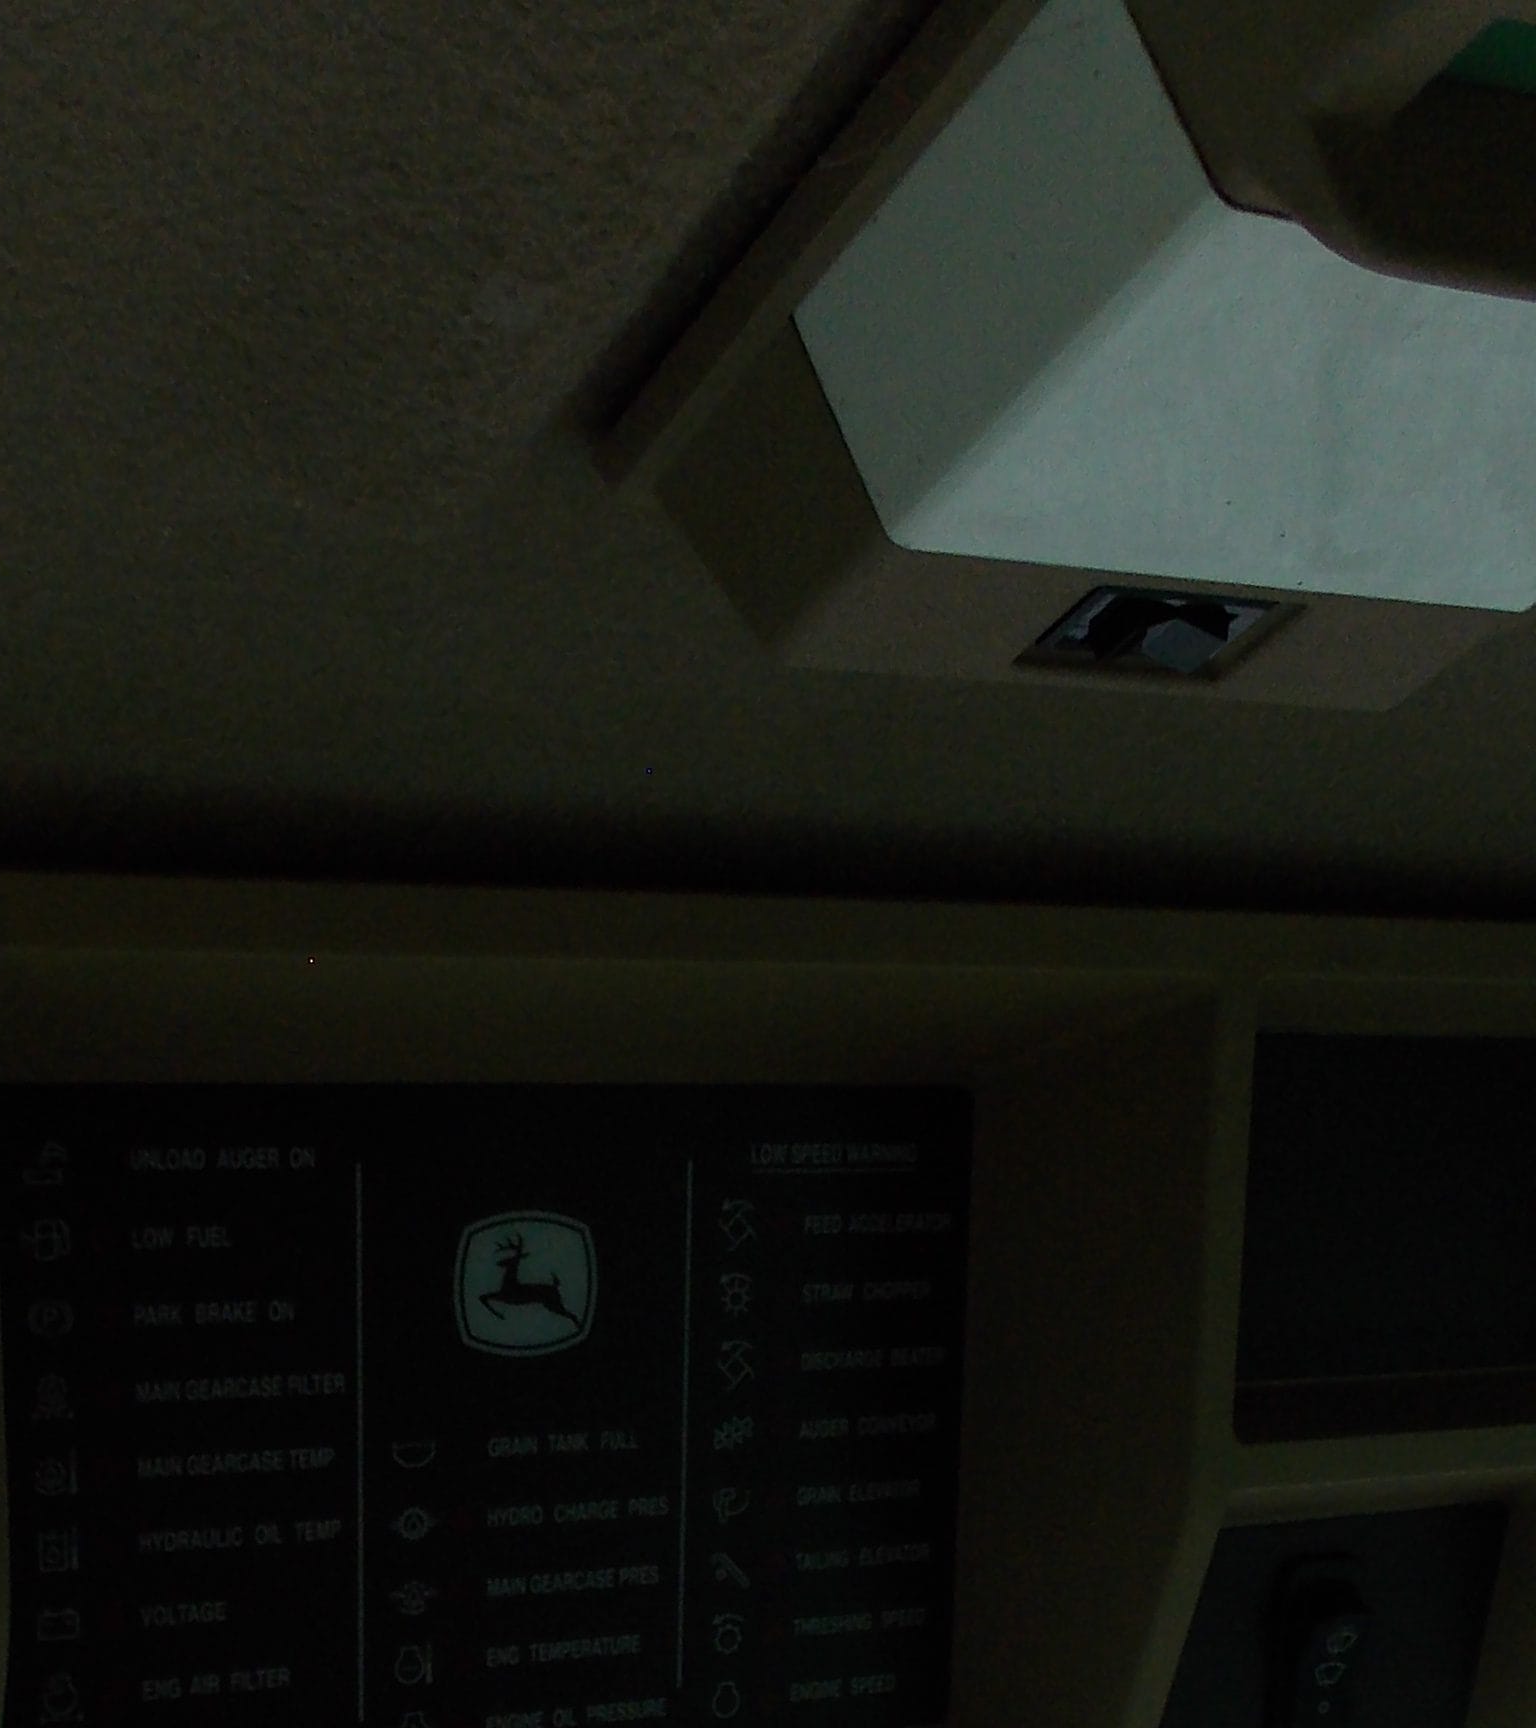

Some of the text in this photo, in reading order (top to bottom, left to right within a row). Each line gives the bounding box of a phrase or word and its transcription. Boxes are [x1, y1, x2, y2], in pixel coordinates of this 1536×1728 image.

[129, 1145, 316, 1171] UNLOAD AUGER ON
[749, 1142, 788, 1165] LOW
[791, 1142, 842, 1165] SPEED
[130, 1225, 232, 1250] LOW FUEL
[133, 1298, 295, 1326] PARK BRAKE ON
[135, 1371, 346, 1404] MAIN GEARCASE FILTER
[487, 1429, 639, 1458] GRAIN TANK FULL
[136, 1446, 335, 1478] MAIN GEARCASE TEMP
[486, 1495, 670, 1528] HYDRO CHARGE PRES
[137, 1518, 342, 1553] HYDRAULIC OIL TEMP
[486, 1564, 660, 1598] MAIN GEARCASE PRES
[139, 1599, 227, 1629] VOLTAGE
[485, 1633, 641, 1668] ENG TEMPERATURE
[141, 1665, 292, 1702] ENG AIR FILTER
[552, 1706, 578, 1728] OIL
[585, 1696, 667, 1723] PRESSURE
